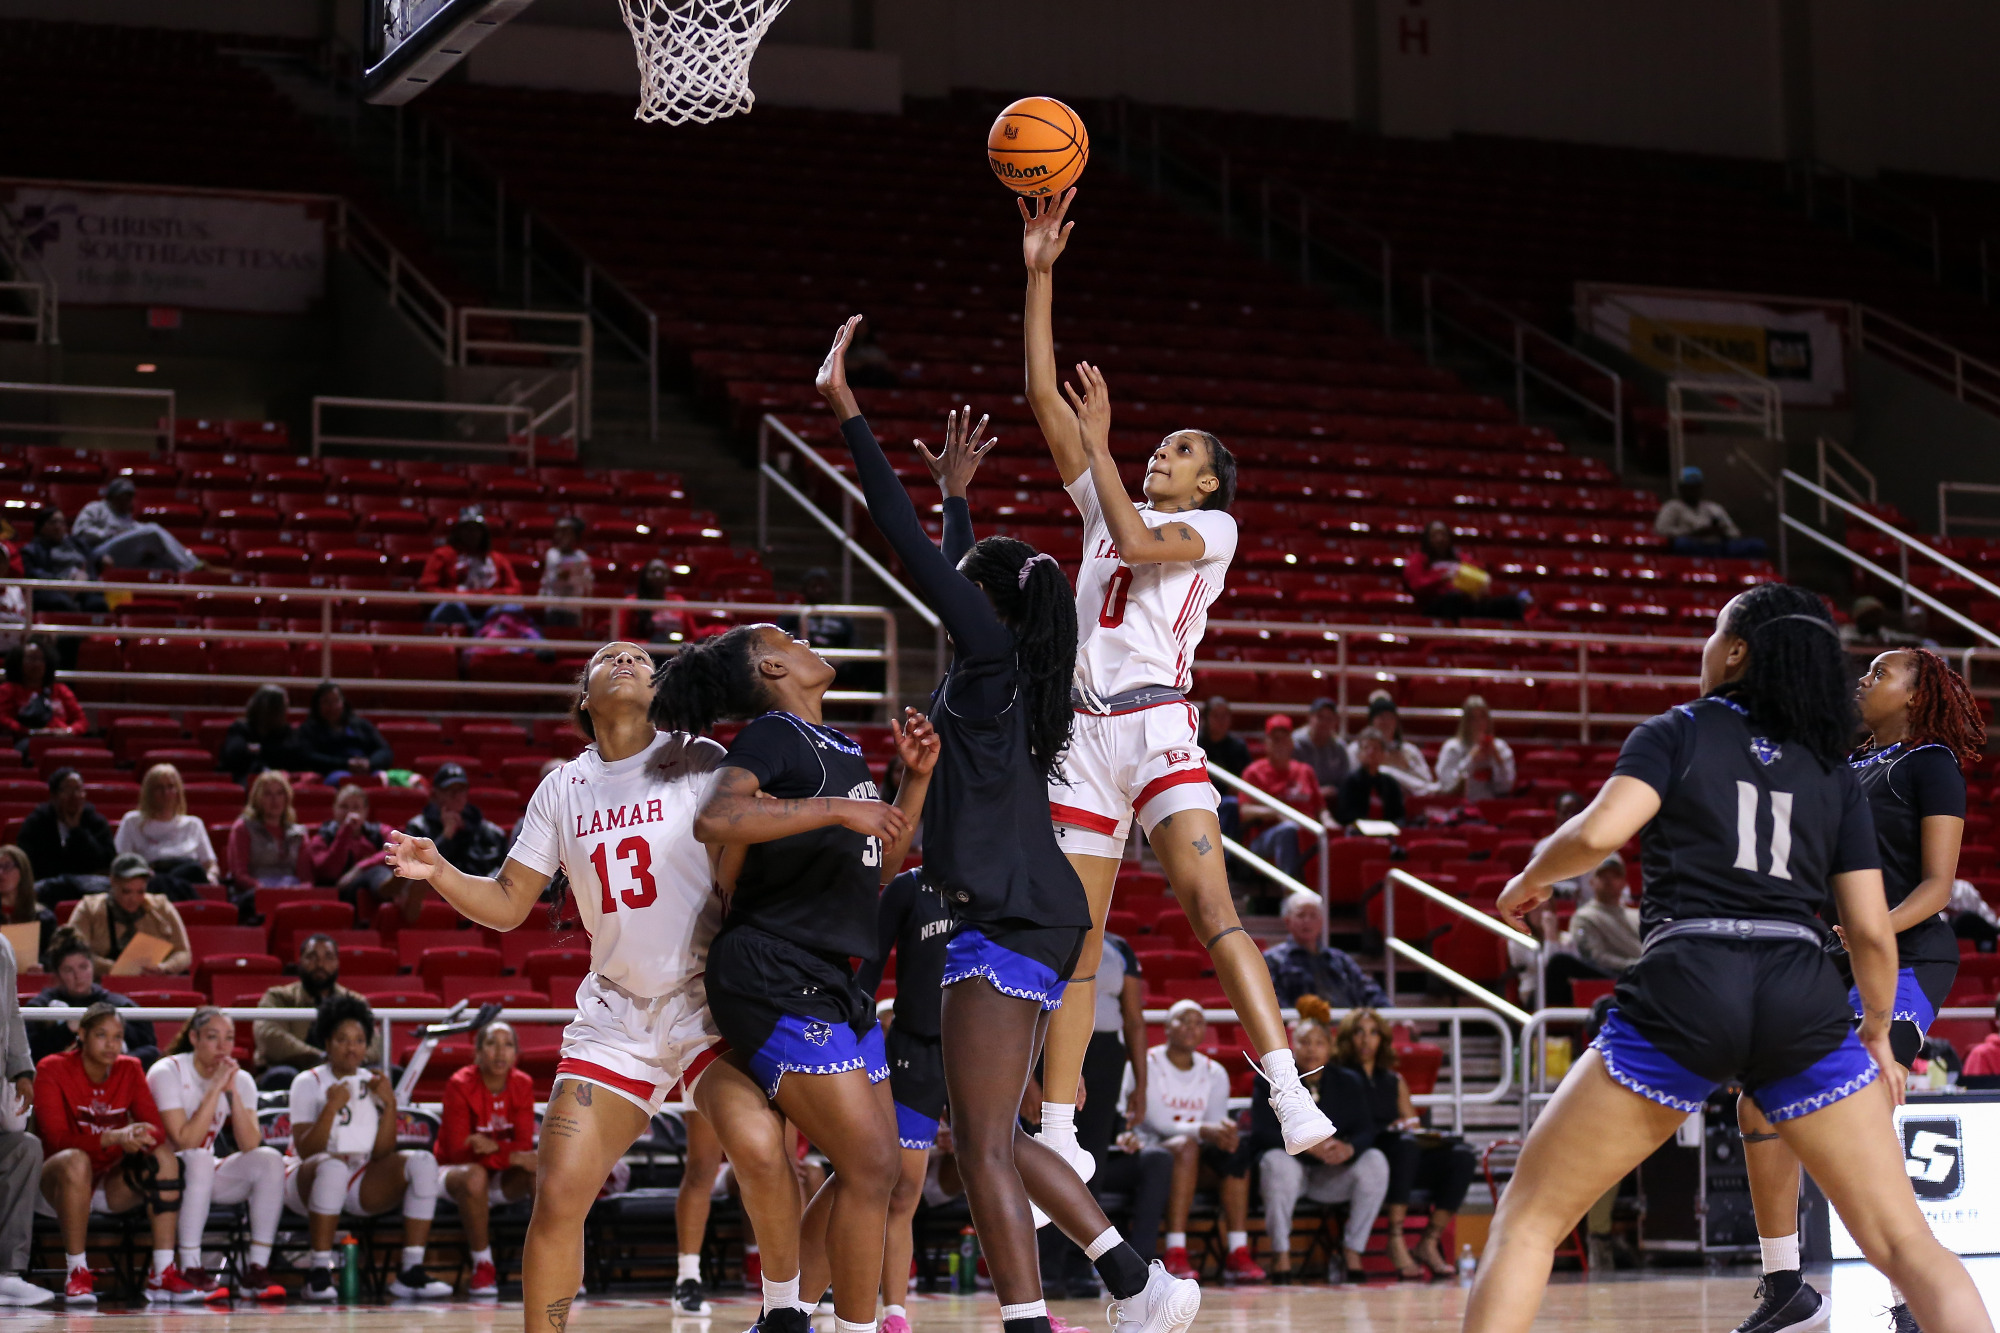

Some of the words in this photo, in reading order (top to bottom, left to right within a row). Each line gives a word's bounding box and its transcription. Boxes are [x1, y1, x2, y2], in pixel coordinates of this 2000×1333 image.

[77, 240, 228, 267] SOUTHEAST
[236, 247, 317, 271] TEXAS
[1098, 565, 1134, 629] 0
[575, 797, 664, 838] LAMAR
[1732, 779, 1794, 881] 11
[589, 834, 658, 915] 13
[920, 918, 949, 941] NEW
